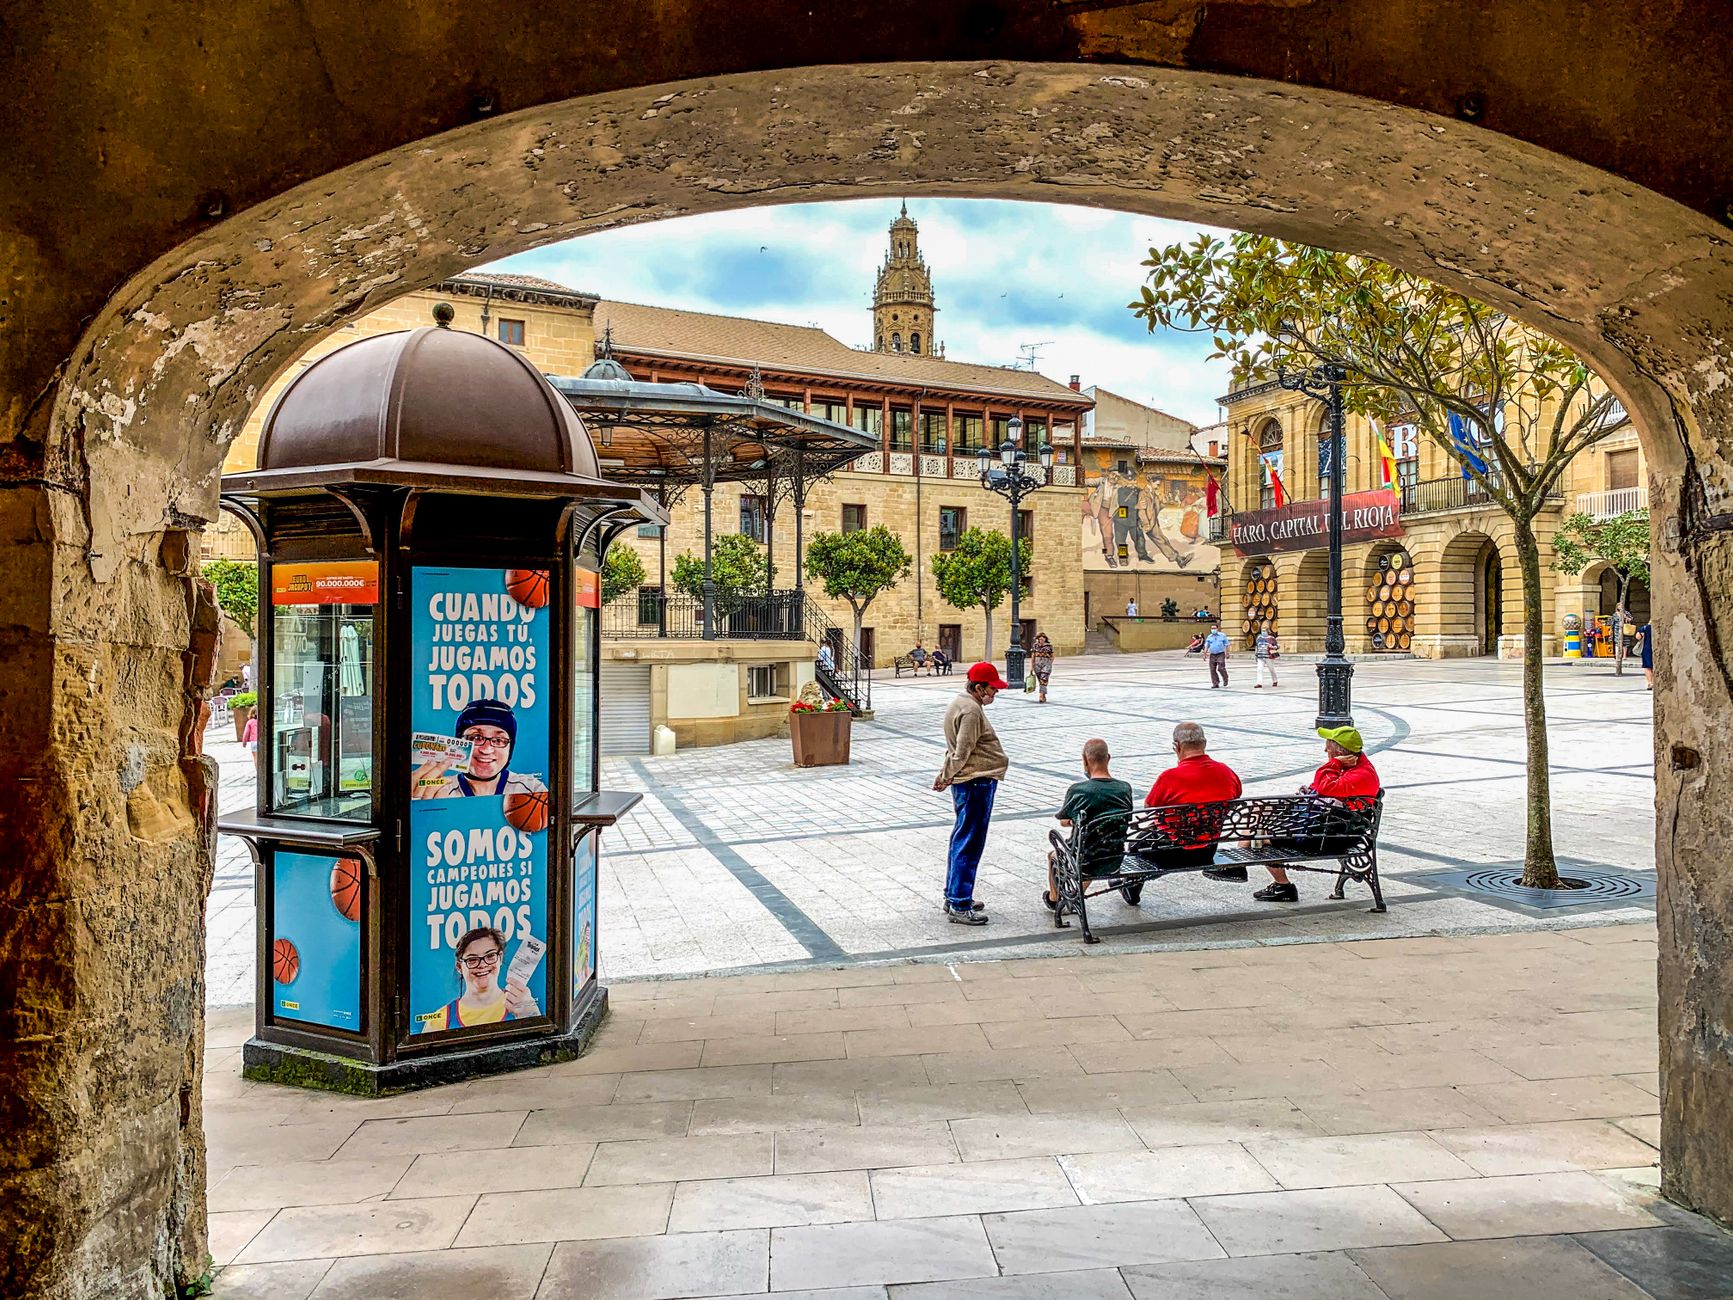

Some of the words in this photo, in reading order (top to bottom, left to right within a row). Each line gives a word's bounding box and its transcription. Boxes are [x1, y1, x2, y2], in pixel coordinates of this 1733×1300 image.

[1233, 523, 1271, 545] HARO,
[1270, 515, 1323, 540] CAPITAL
[1354, 504, 1394, 531] RIOJA
[315, 579, 365, 588] 90.000.000€
[429, 592, 536, 622] CUANDO
[432, 624, 498, 642] JUEGAS
[507, 620, 533, 644] TÚ,
[428, 645, 536, 671] JUGAMOS
[428, 673, 536, 711] TODOS
[427, 826, 533, 867] SOMOS
[427, 862, 513, 884] CAMPEONES
[520, 860, 533, 876] SI
[427, 878, 531, 912] JUGAMOS
[427, 904, 531, 950] TODOS
